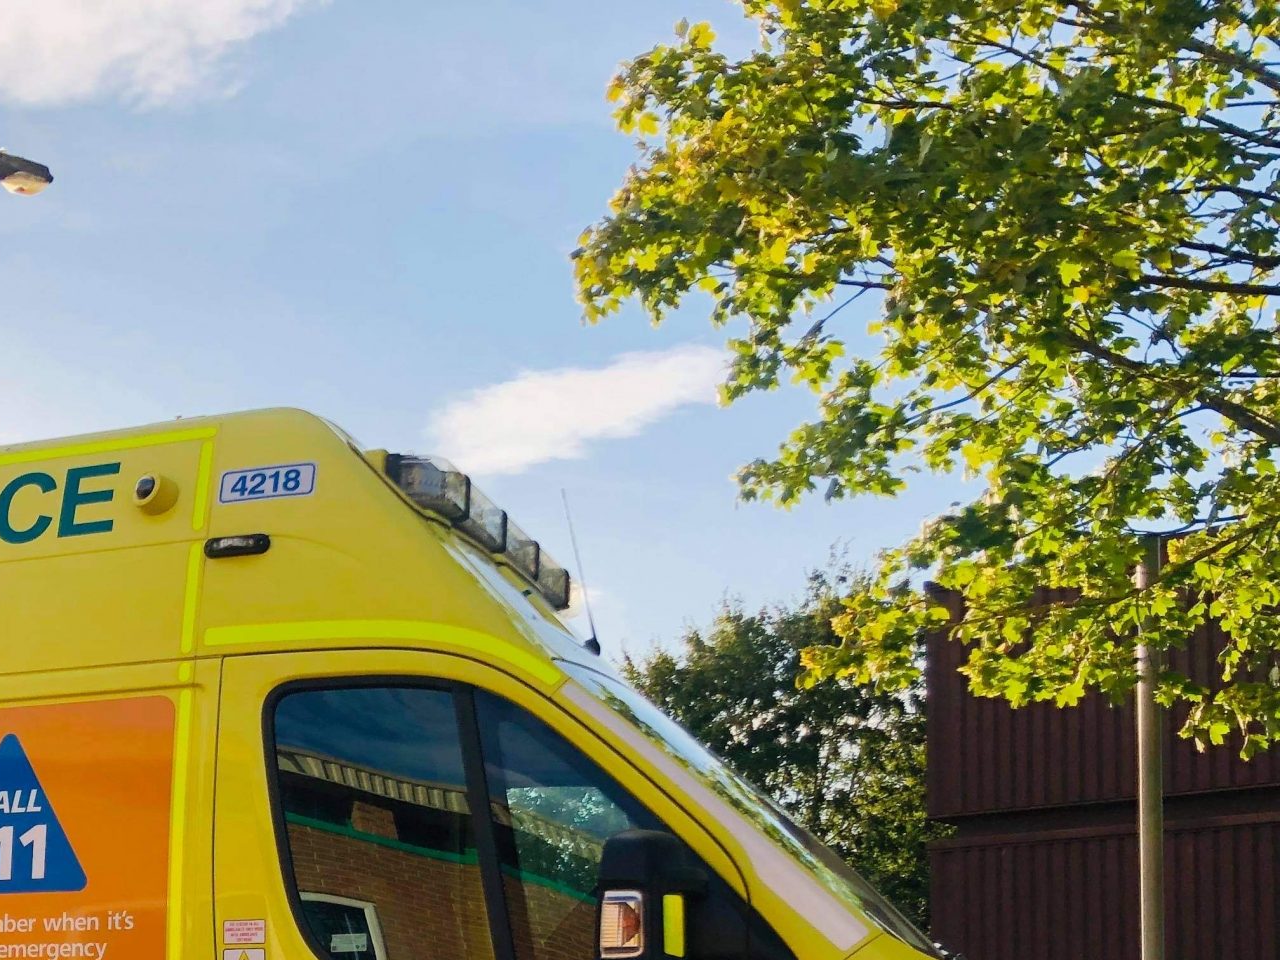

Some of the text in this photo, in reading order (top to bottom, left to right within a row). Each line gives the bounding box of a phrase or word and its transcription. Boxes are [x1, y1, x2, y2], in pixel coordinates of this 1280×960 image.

[230, 469, 301, 497] 4218
[43, 912, 99, 932] when
[107, 910, 134, 931] it's
